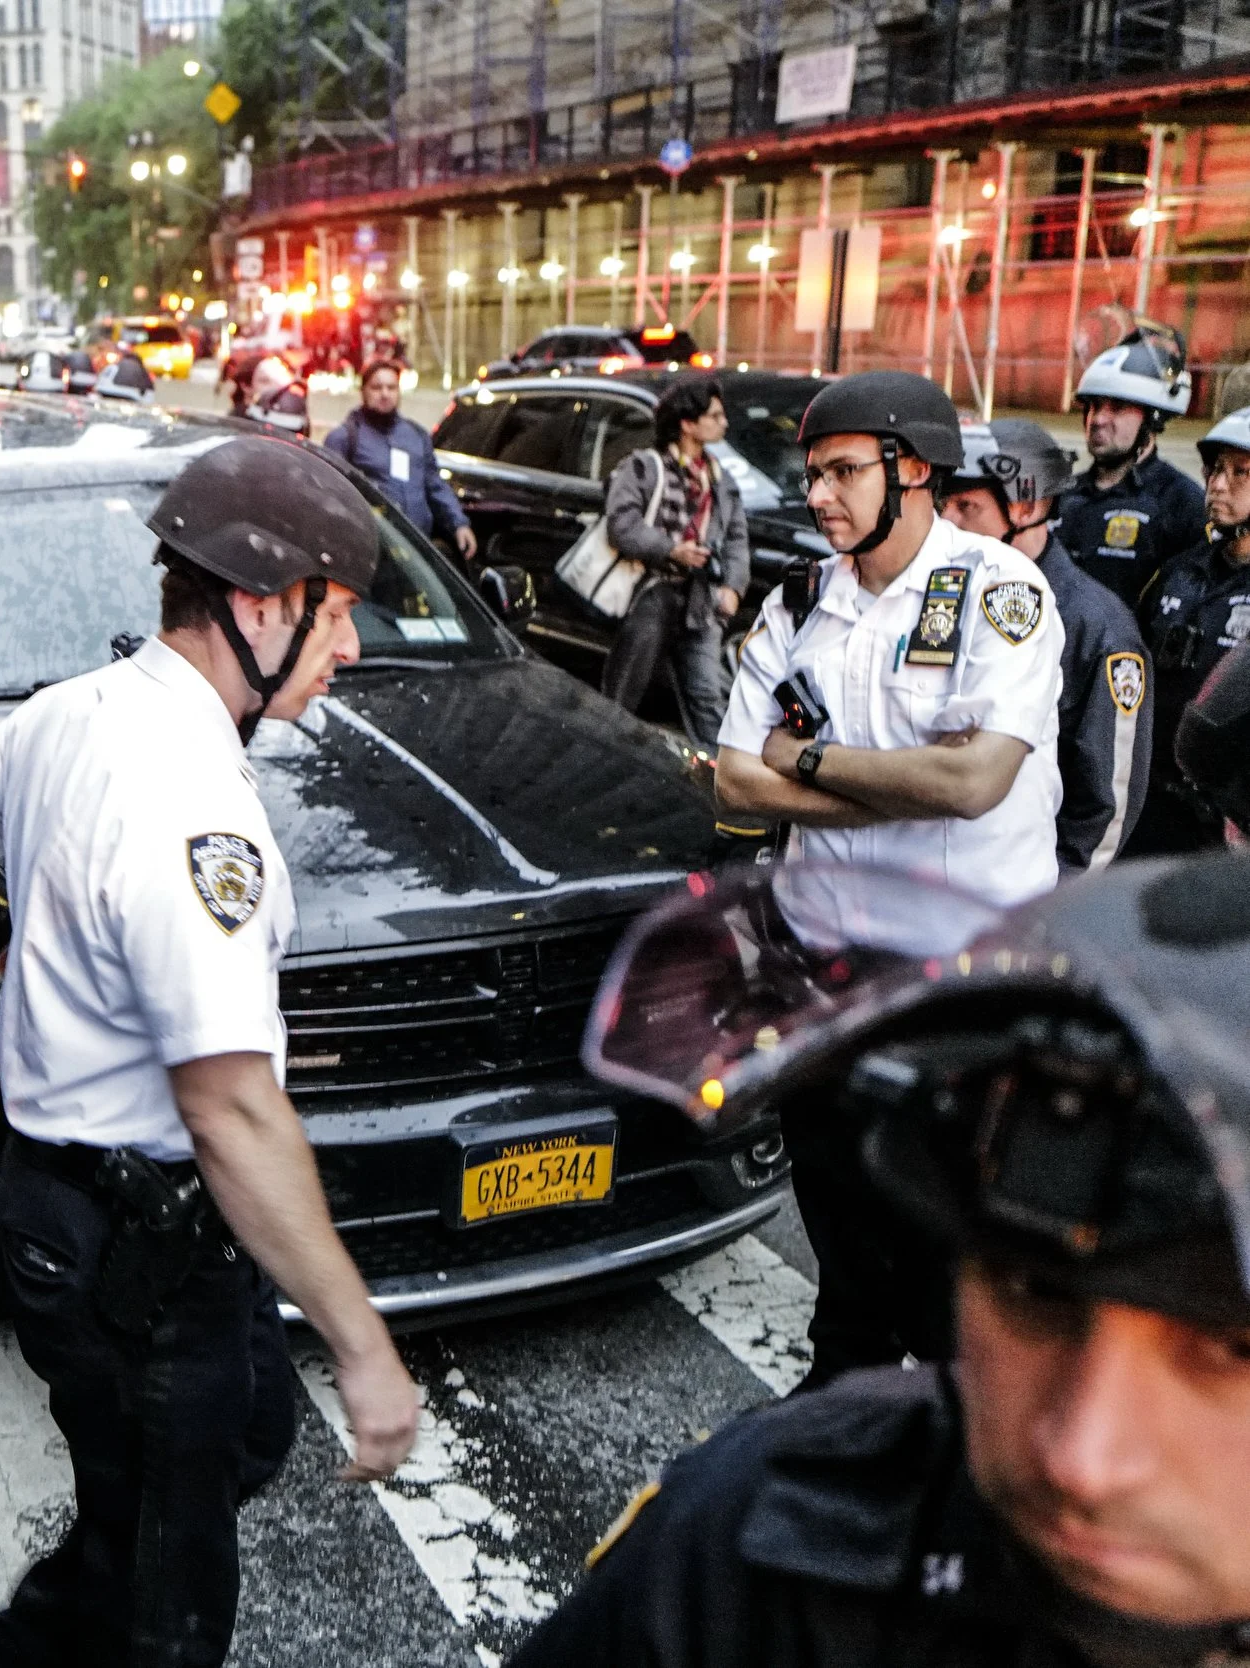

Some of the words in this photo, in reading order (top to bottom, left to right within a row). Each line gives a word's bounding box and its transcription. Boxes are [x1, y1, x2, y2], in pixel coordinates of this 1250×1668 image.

[207, 834, 249, 853] POLICE
[502, 1142, 537, 1159] NEW
[541, 1135, 579, 1152] YORK
[496, 1197, 536, 1212] EMPIRE
[542, 1190, 571, 1203] STATE
